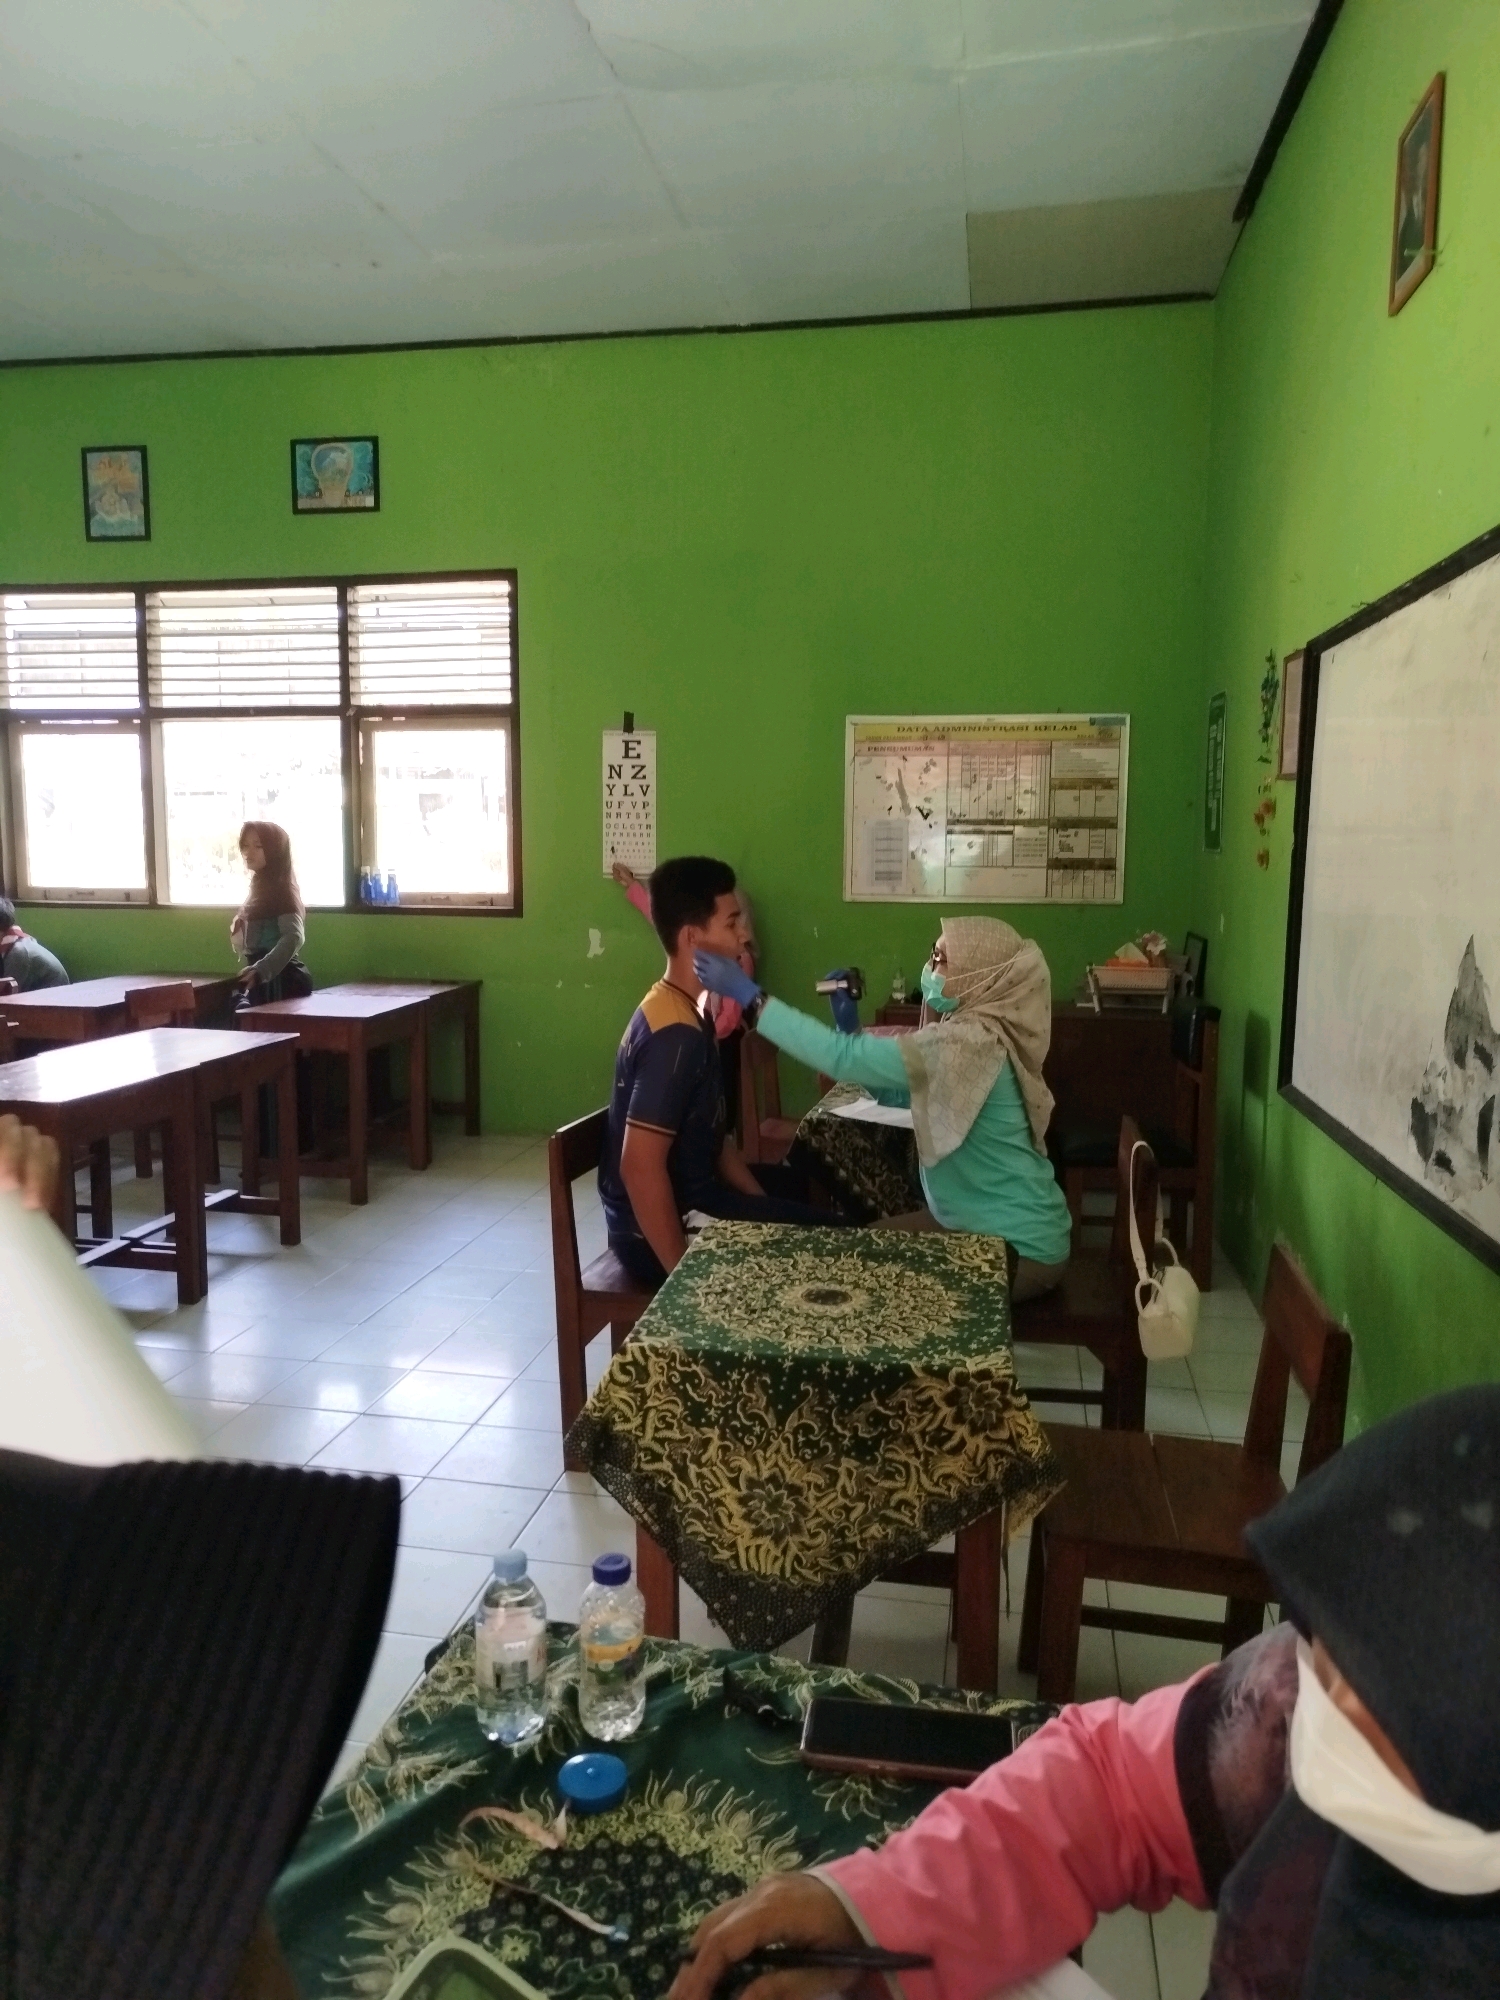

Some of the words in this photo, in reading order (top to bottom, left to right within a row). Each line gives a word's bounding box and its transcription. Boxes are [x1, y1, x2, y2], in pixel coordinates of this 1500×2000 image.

[896, 725, 929, 734] DATA
[621, 739, 642, 760] E
[607, 763, 624, 780] N
[630, 764, 647, 780] Z
[605, 783, 617, 797] Y
[622, 783, 635, 797] L
[638, 783, 651, 798] V
[605, 800, 613, 810] U
[617, 800, 625, 810] F
[630, 800, 638, 810] V
[642, 800, 650, 810] P
